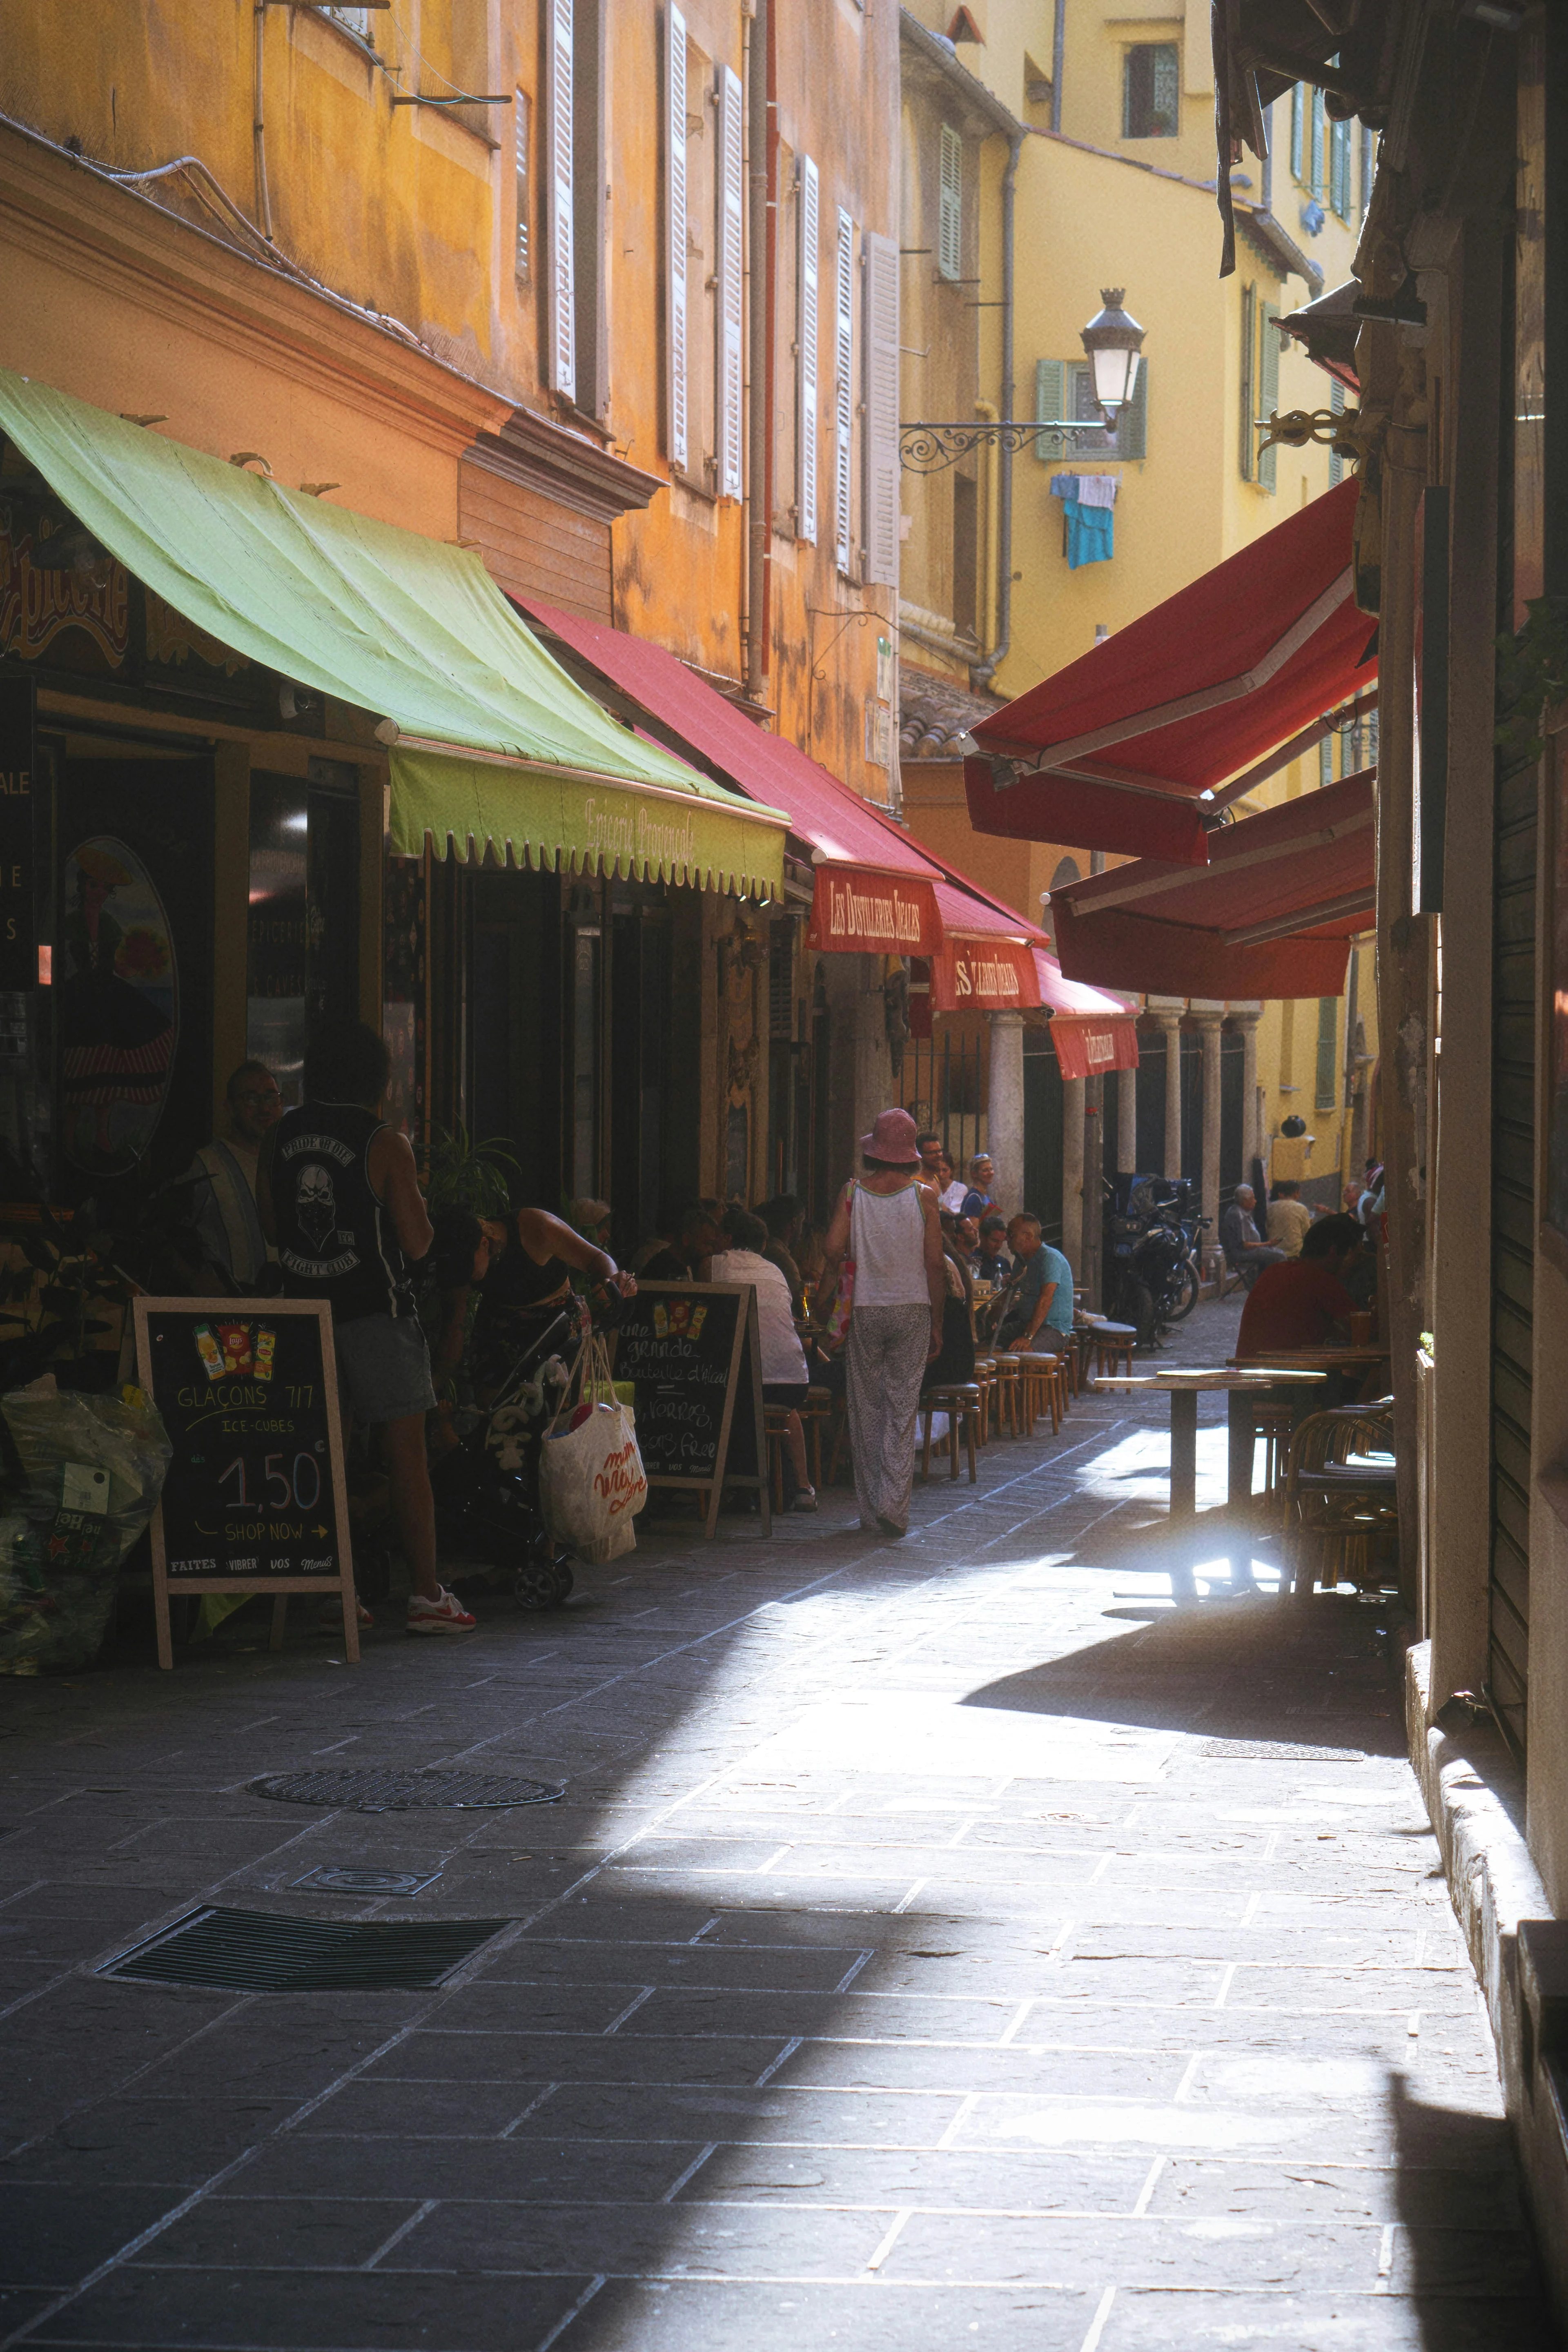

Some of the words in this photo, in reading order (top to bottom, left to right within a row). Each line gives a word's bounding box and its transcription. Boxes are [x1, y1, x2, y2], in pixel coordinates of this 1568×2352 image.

[285, 1136, 318, 1156] PRIDE
[319, 1138, 332, 1151] OR
[332, 1143, 352, 1162] DIE
[340, 1233, 352, 1243] FC
[286, 1253, 320, 1275] FIGHT
[326, 1254, 353, 1274] CLUB
[178, 1385, 267, 1410] GLAÇONS
[222, 1419, 294, 1432] ICE-CUBES
[225, 1523, 265, 1541] SHOP
[270, 1523, 303, 1540] NOW
[171, 1558, 216, 1572] FAITES
[227, 1558, 258, 1571] VIBRER
[270, 1558, 290, 1569] VOS
